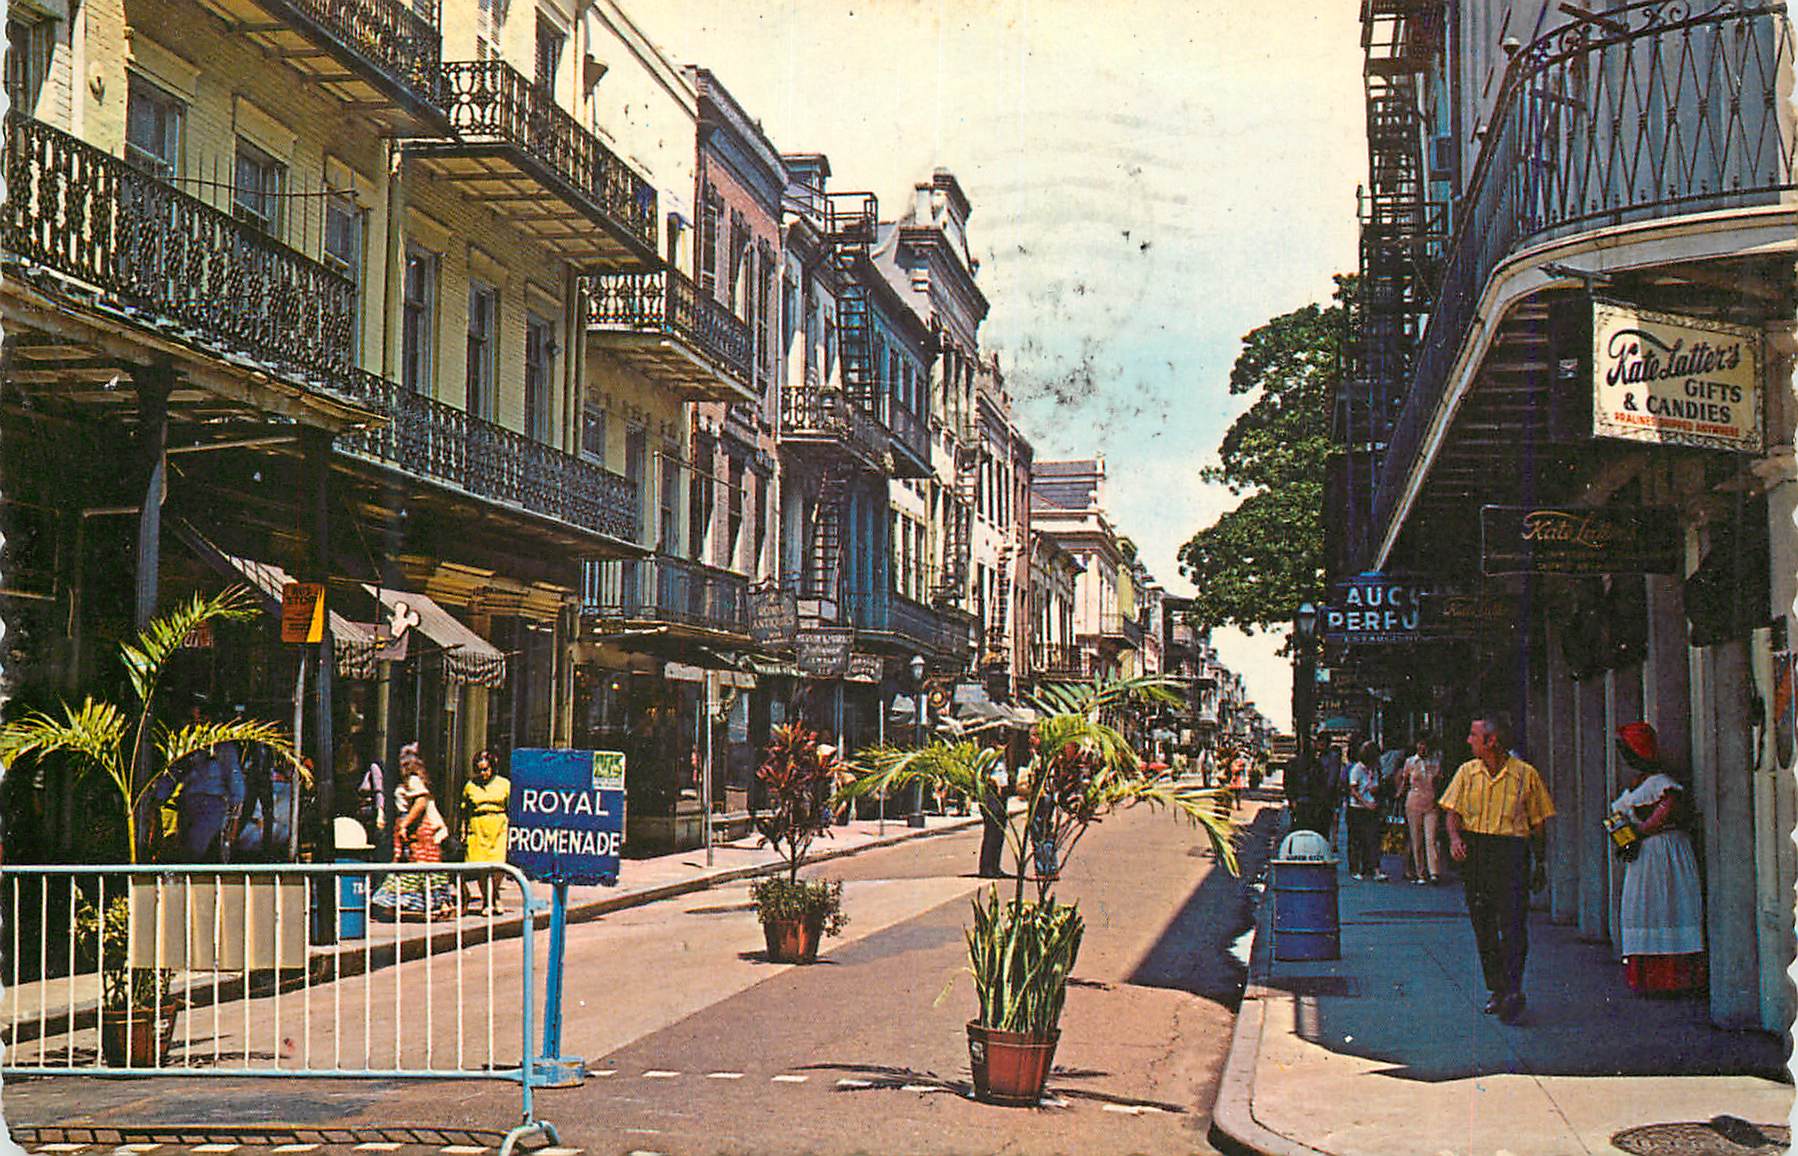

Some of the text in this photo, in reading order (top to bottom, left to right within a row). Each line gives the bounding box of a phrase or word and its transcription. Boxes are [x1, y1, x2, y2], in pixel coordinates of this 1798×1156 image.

[1606, 329, 1741, 386] Kate Latter's
[1685, 378, 1742, 404] GIFTS
[1614, 411, 1657, 427] PRALINES
[1623, 392, 1732, 425] & CANDIES
[523, 788, 610, 817] ROYAL
[507, 826, 620, 857] PROMENADE
